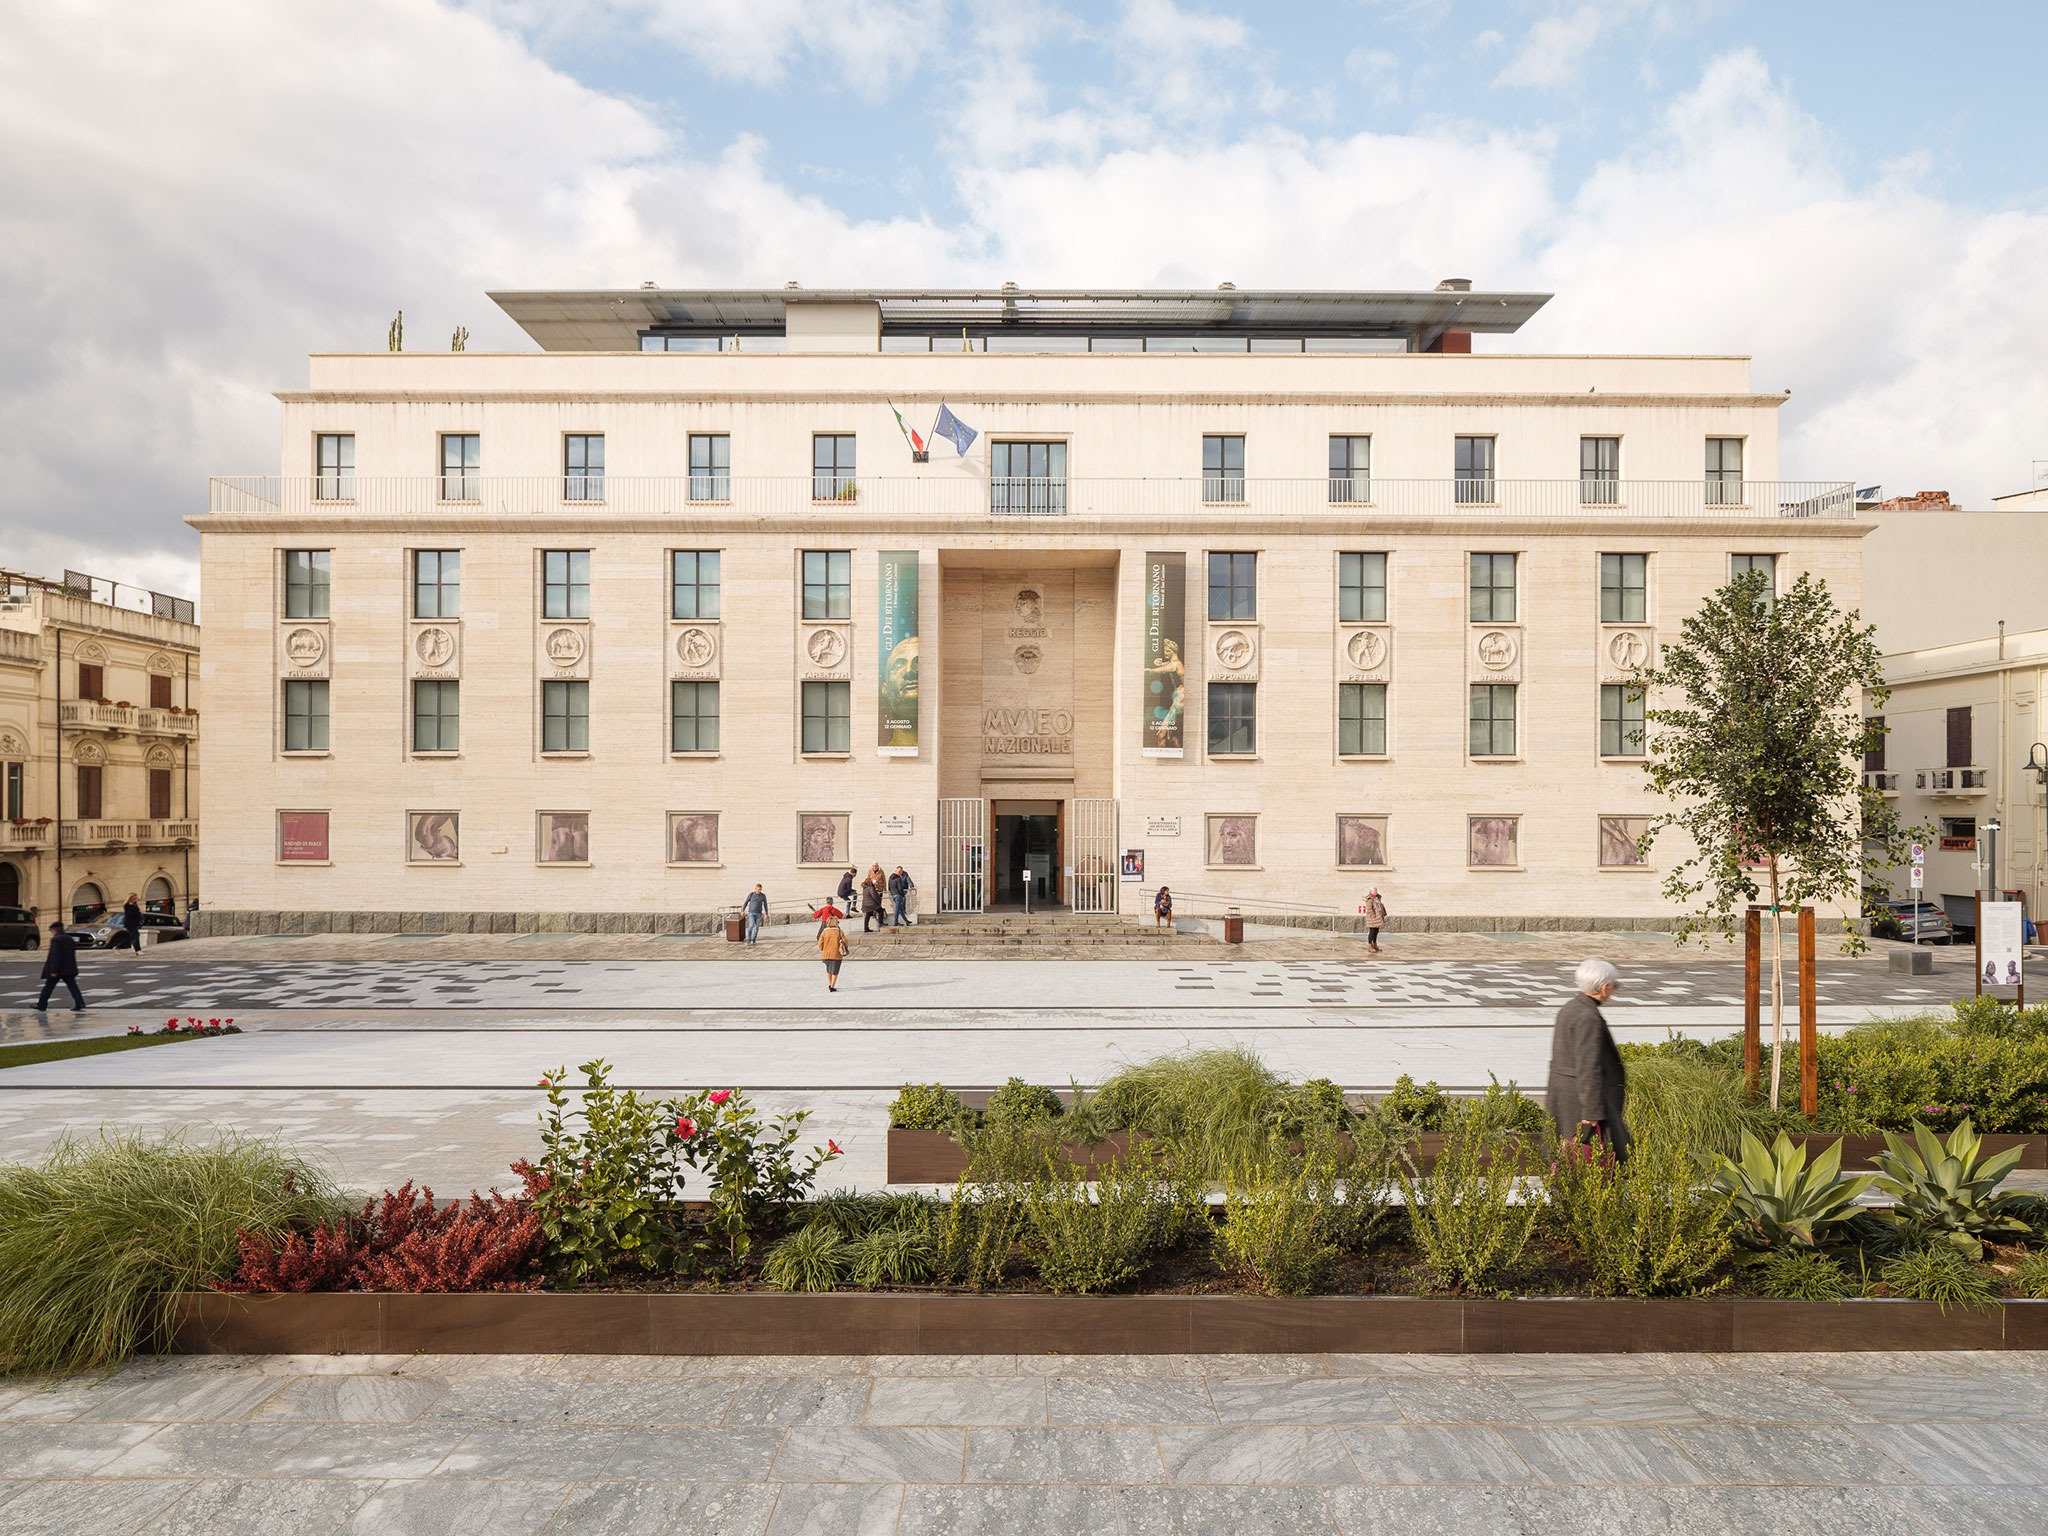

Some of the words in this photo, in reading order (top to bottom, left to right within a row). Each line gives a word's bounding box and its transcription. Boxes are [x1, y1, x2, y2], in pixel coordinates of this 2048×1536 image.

[885, 563, 893, 615] RITORNANO
[1151, 564, 1160, 616] RITORNANO
[1008, 628, 1047, 638] REGGIO
[885, 637, 893, 651] GLI
[1151, 638, 1159, 652] GLI
[985, 736, 1072, 754] NAZIONALE
